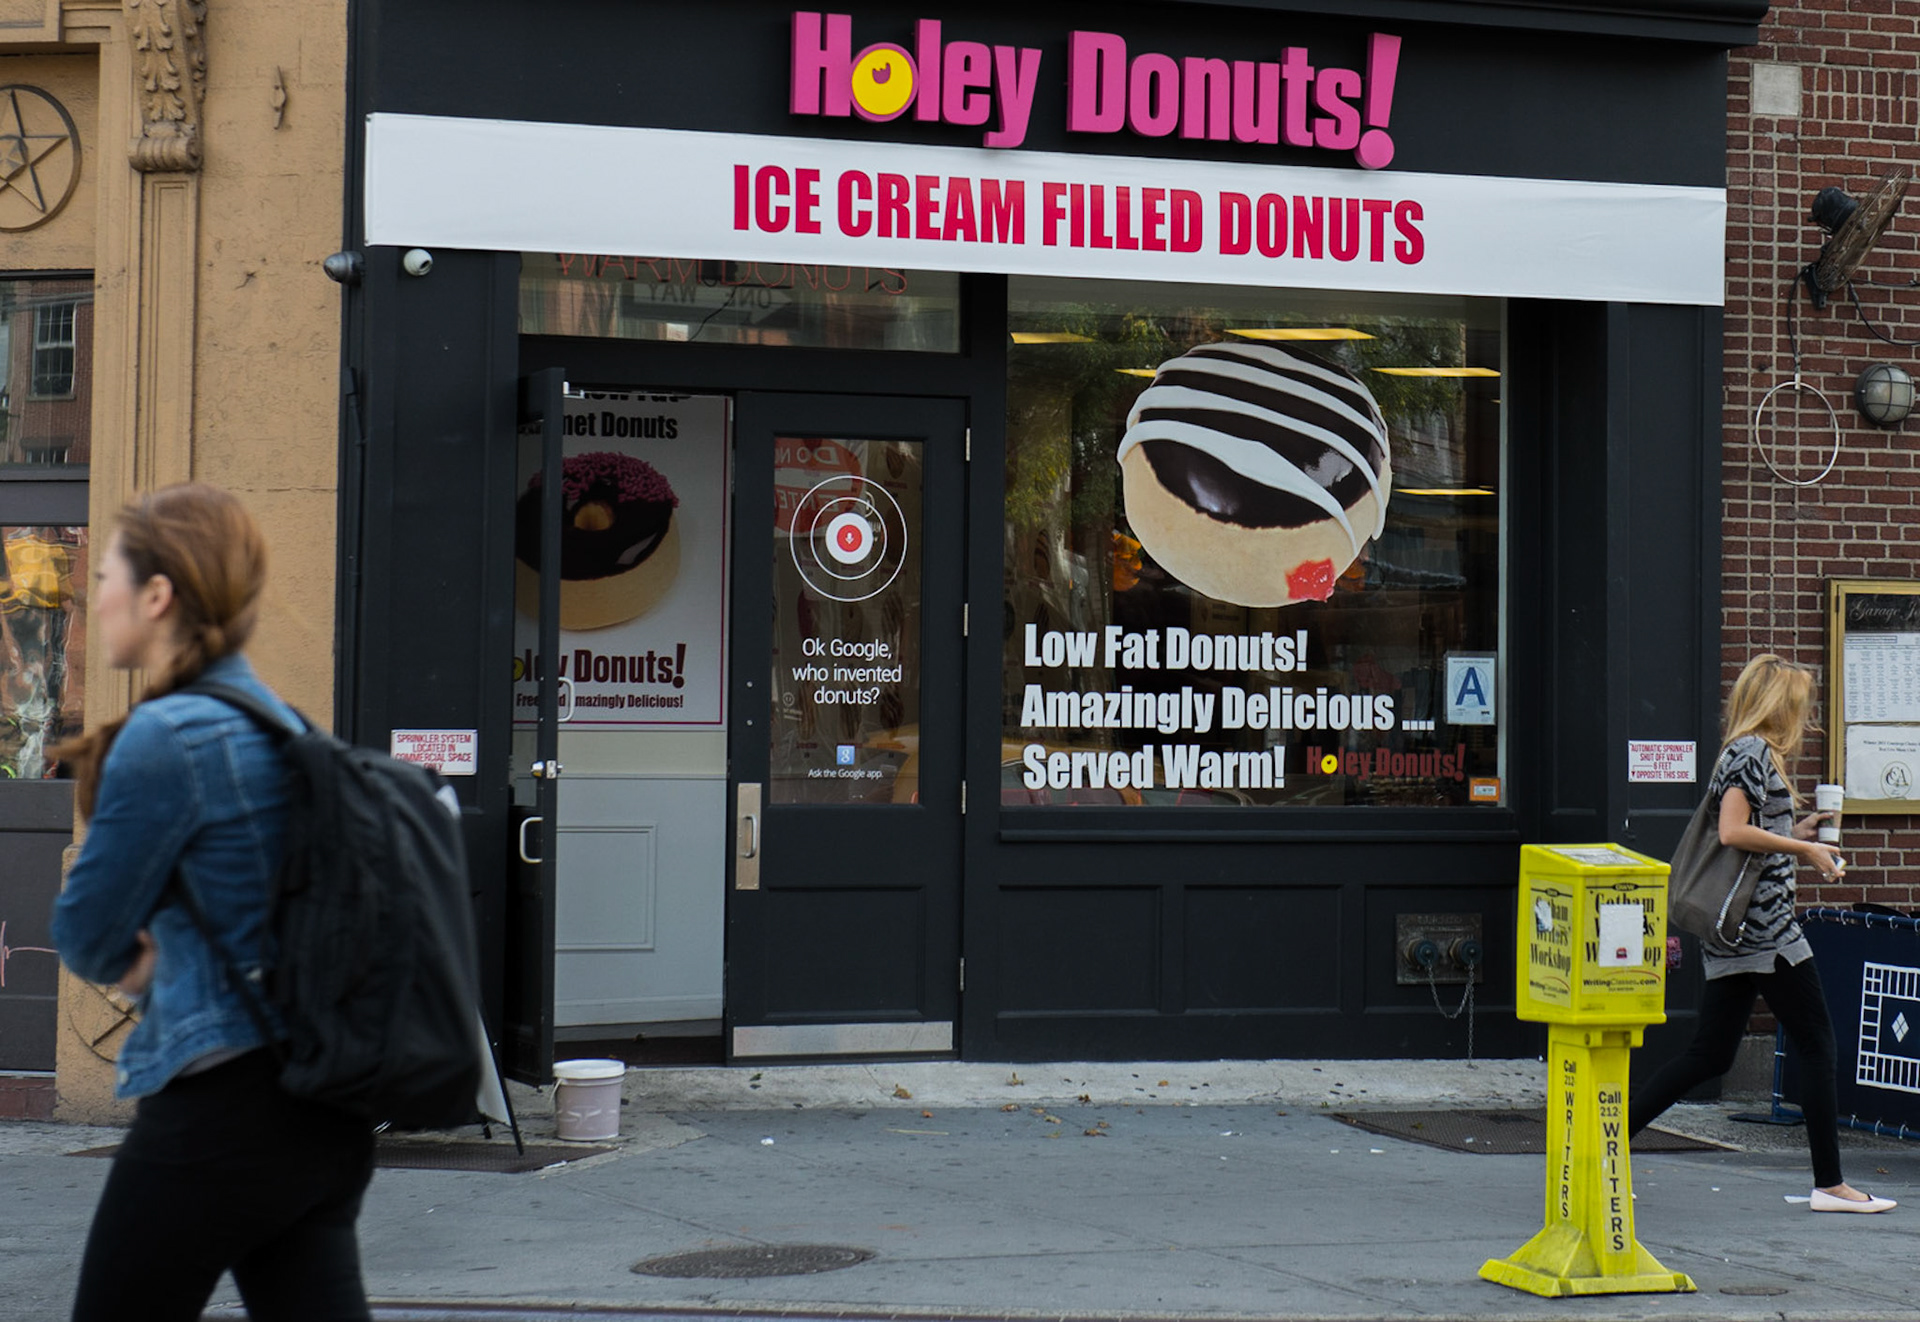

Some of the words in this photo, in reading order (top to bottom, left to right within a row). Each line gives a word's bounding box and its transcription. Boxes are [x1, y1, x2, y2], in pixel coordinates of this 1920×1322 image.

[789, 11, 1042, 148] Holey
[1066, 30, 1402, 170] Donuts!
[734, 164, 821, 234] ICE
[838, 170, 1025, 244] CREAM
[1042, 182, 1203, 253] FILLED
[1219, 191, 1424, 265] DONUTS
[602, 412, 678, 439] Donuts
[802, 638, 826, 656] Ok
[830, 639, 892, 661] Google,
[1024, 623, 1098, 668] Low
[1104, 625, 1160, 669] Fat
[1166, 627, 1308, 672] Donuts!
[574, 643, 686, 688] Donuts!
[792, 663, 829, 682] who
[833, 663, 902, 682] invented
[813, 686, 880, 704] donuts?
[1456, 667, 1486, 706] A
[575, 694, 625, 709] mazingly
[627, 694, 684, 708] Delicious!
[1020, 684, 1215, 734] Amazingly
[1222, 686, 1395, 731] Delicious
[397, 734, 439, 743] SPRINKLER
[441, 734, 471, 743] SYSTEM
[412, 744, 446, 752] LOCATED
[448, 744, 456, 752] IN
[1631, 744, 1662, 752] AUTOMATIC
[1663, 744, 1693, 753] SPRINKLER
[396, 753, 445, 762] COMMERCIAL
[448, 753, 472, 762] SPACE
[1023, 744, 1154, 789] Served
[1162, 744, 1285, 789] Warm!
[1306, 746, 1373, 780] Holey
[1376, 743, 1466, 782] Donuts!
[1640, 753, 1654, 761] SHUT
[1656, 753, 1665, 761] OFF
[808, 768, 822, 778] Ask
[823, 769, 837, 778] the
[838, 768, 865, 780] Google
[866, 770, 883, 780] app.
[1636, 771, 1662, 779] OPPOSITE
[1663, 771, 1676, 779] THIS
[1677, 771, 1689, 779] SIDE
[1531, 943, 1571, 977] Workshop
[1563, 1060, 1576, 1073] Call
[1599, 1091, 1621, 1104] Call
[1600, 1106, 1621, 1117] 212-
[1561, 1091, 1574, 1218] WRITERS
[1603, 1122, 1624, 1251] WRITERS
